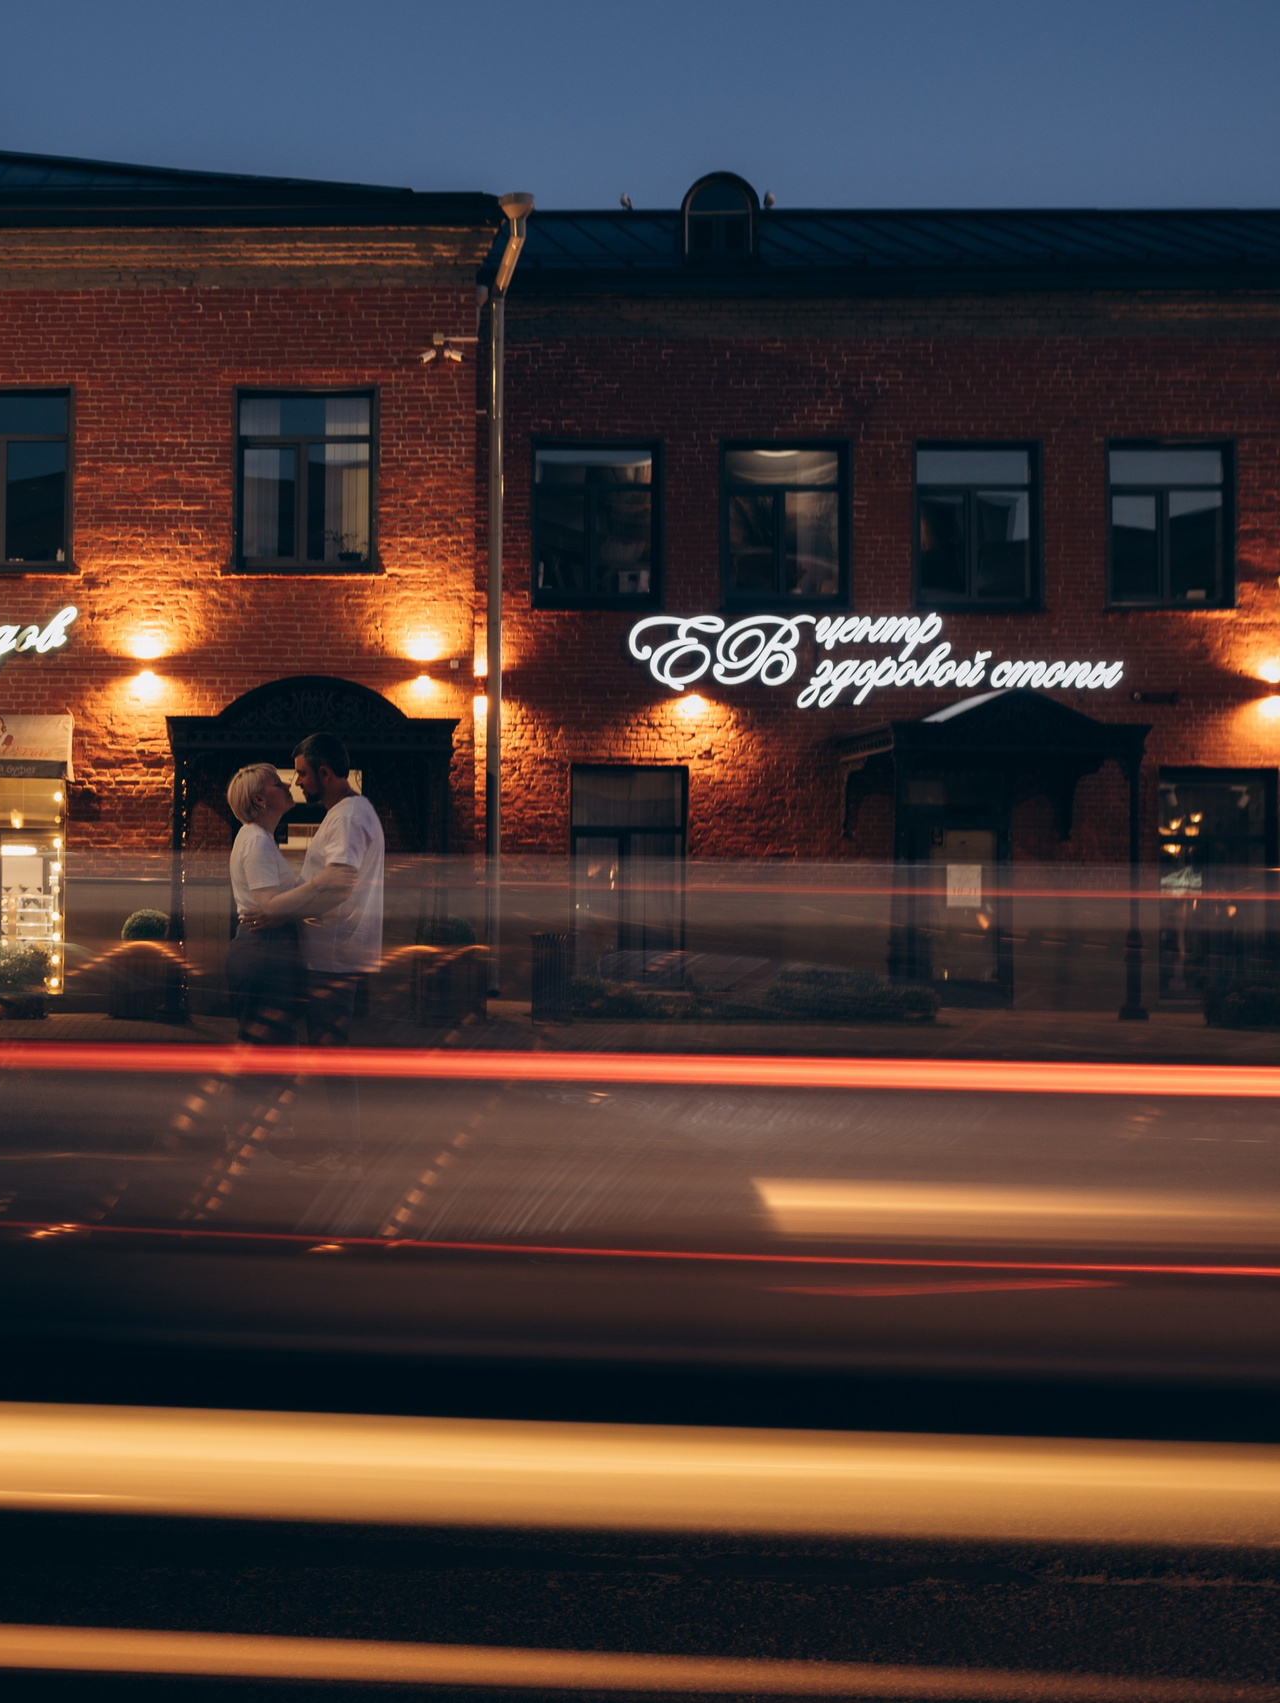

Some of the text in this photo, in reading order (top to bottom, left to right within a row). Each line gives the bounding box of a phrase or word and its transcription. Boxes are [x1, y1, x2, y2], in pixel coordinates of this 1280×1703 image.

[815, 612, 942, 661] центр
[797, 642, 1123, 708] здоровой стопы
[6, 763, 37, 775] буфет
